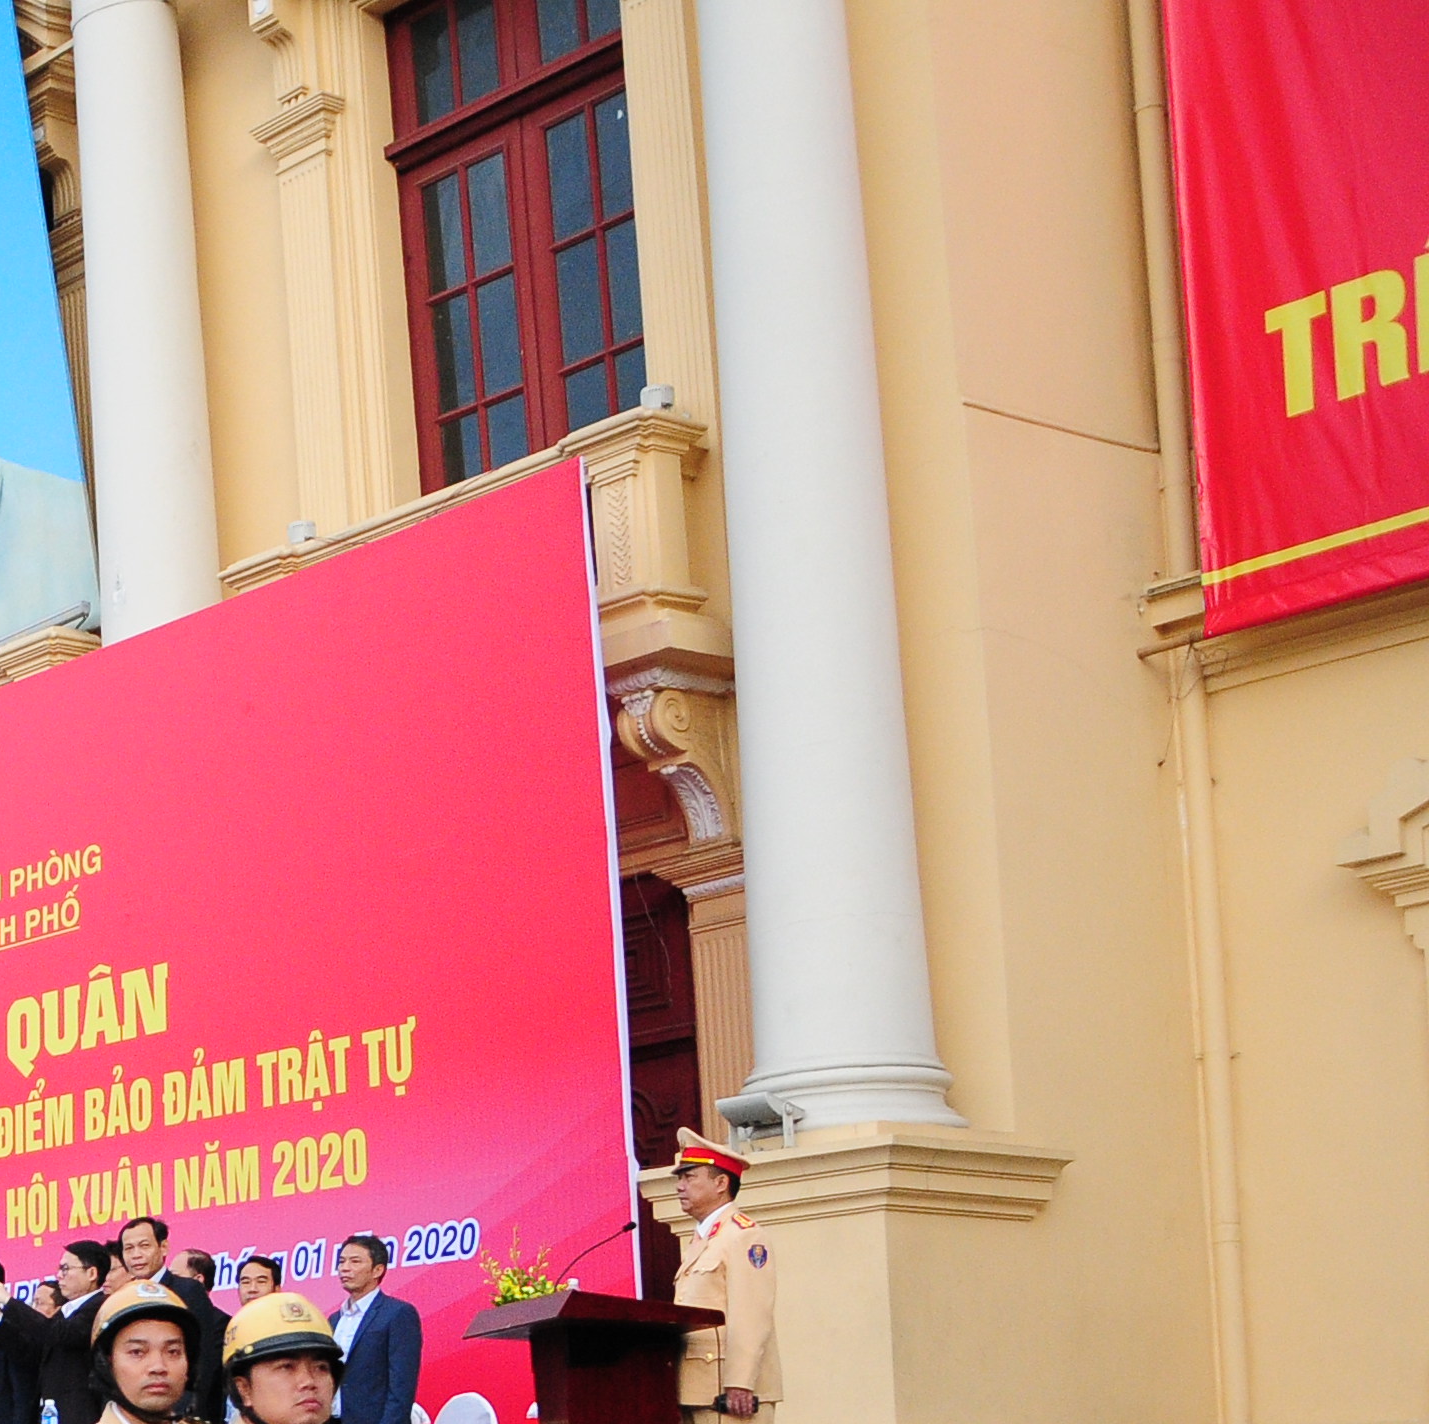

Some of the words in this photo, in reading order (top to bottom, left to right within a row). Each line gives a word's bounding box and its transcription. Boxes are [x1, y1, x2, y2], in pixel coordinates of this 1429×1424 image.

[10, 844, 102, 898] PHÒNG
[25, 884, 80, 938] PHỐ
[6, 962, 168, 1078] QUÂN
[84, 1063, 152, 1145] BẢO
[162, 1047, 245, 1127] ĐẢM
[256, 1030, 352, 1112] TRẬT
[361, 1015, 417, 1098] TỰ
[6, 1172, 58, 1247] HỘI
[69, 1157, 162, 1228] XUÂN
[173, 1140, 260, 1212] NĂM
[272, 1127, 368, 1198] 2020
[294, 1242, 322, 1277] 01
[405, 1222, 477, 1263] 2020
